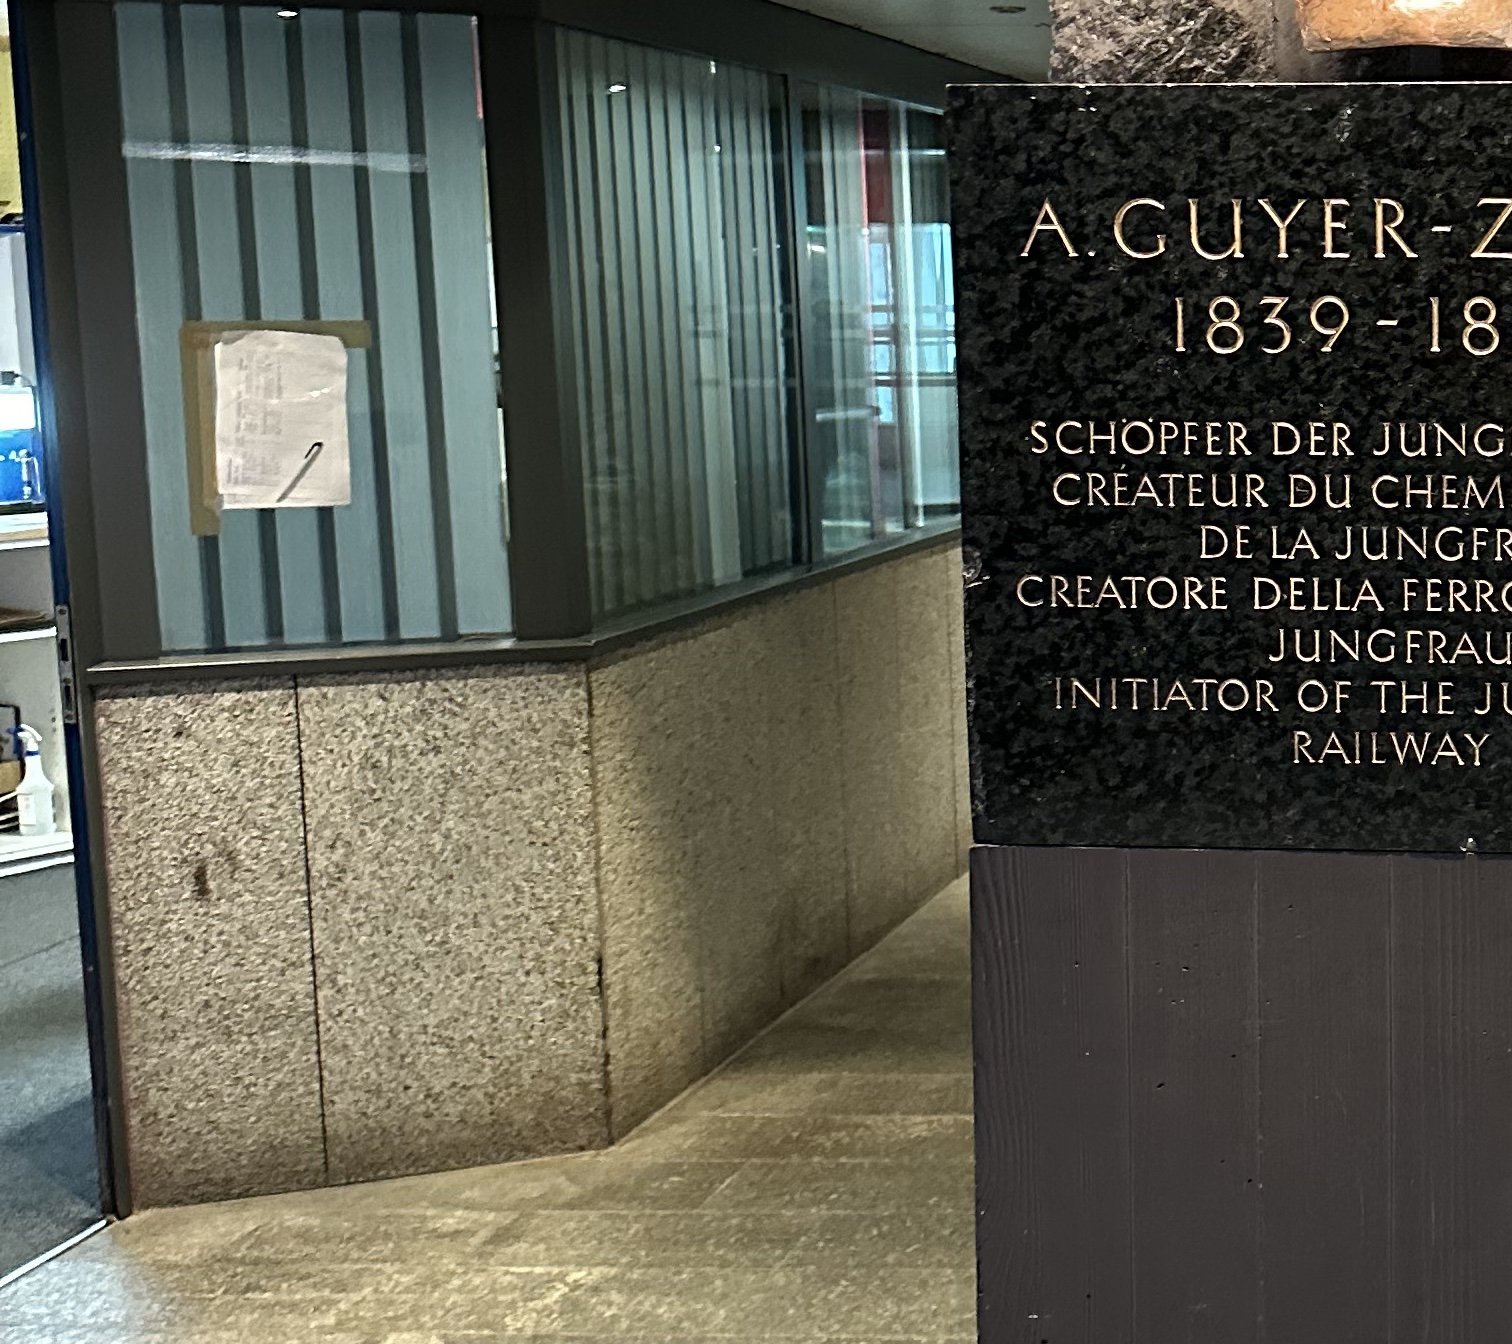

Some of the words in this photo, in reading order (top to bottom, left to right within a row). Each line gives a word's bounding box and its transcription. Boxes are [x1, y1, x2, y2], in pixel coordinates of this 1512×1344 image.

[1030, 417, 1253, 457] SCHÖPFER
[1271, 421, 1355, 457] DER
[1052, 464, 1270, 508] CRÉATEUR
[1288, 472, 1352, 509] DU
[1199, 525, 1253, 560] DE
[1270, 525, 1321, 560] LA
[1016, 574, 1229, 611] CREATORE
[1253, 575, 1386, 612] DELLA
[1268, 628, 1512, 667] JUNGFRAU
[1054, 676, 1280, 712] INITIATOR
[1297, 679, 1353, 714] OF
[1369, 680, 1456, 716] THE
[1292, 730, 1490, 767] RAILWAY
